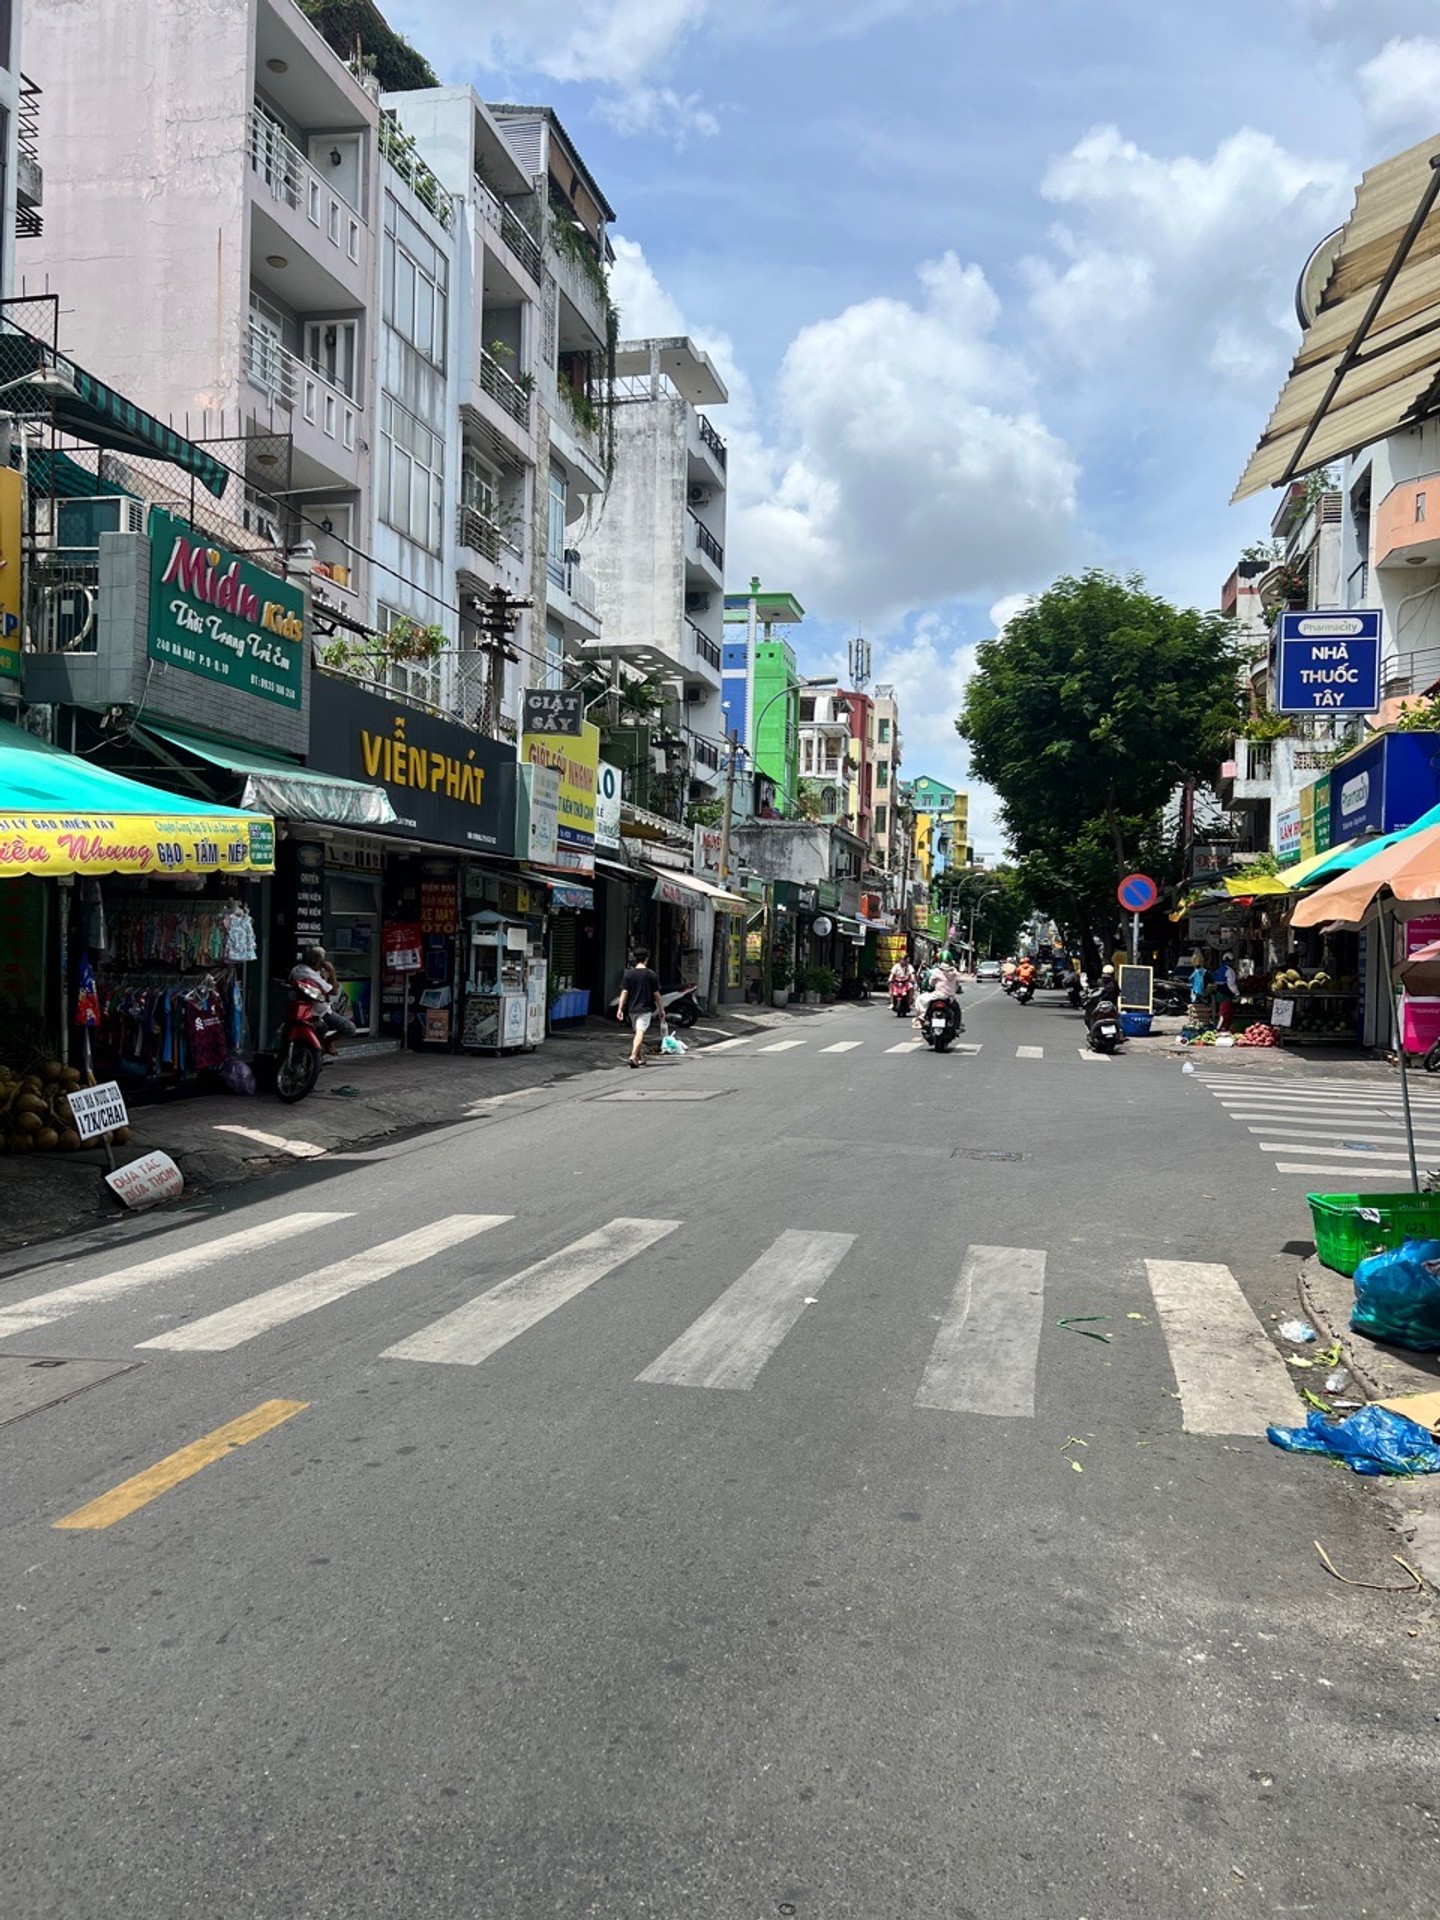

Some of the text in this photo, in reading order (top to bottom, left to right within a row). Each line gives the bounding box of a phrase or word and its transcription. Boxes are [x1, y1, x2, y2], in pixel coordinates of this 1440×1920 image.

[260, 601, 303, 642] Kids
[1303, 620, 1358, 632] Pharmacity
[205, 615, 245, 658] Trang
[1311, 642, 1349, 660] NHÀ
[1300, 663, 1358, 684] THUỐC
[528, 692, 578, 714] GIẶT
[1313, 689, 1345, 706] TÂY
[531, 711, 573, 731] SẤY
[57, 834, 153, 869] Nhung
[156, 842, 184, 869] GẠO
